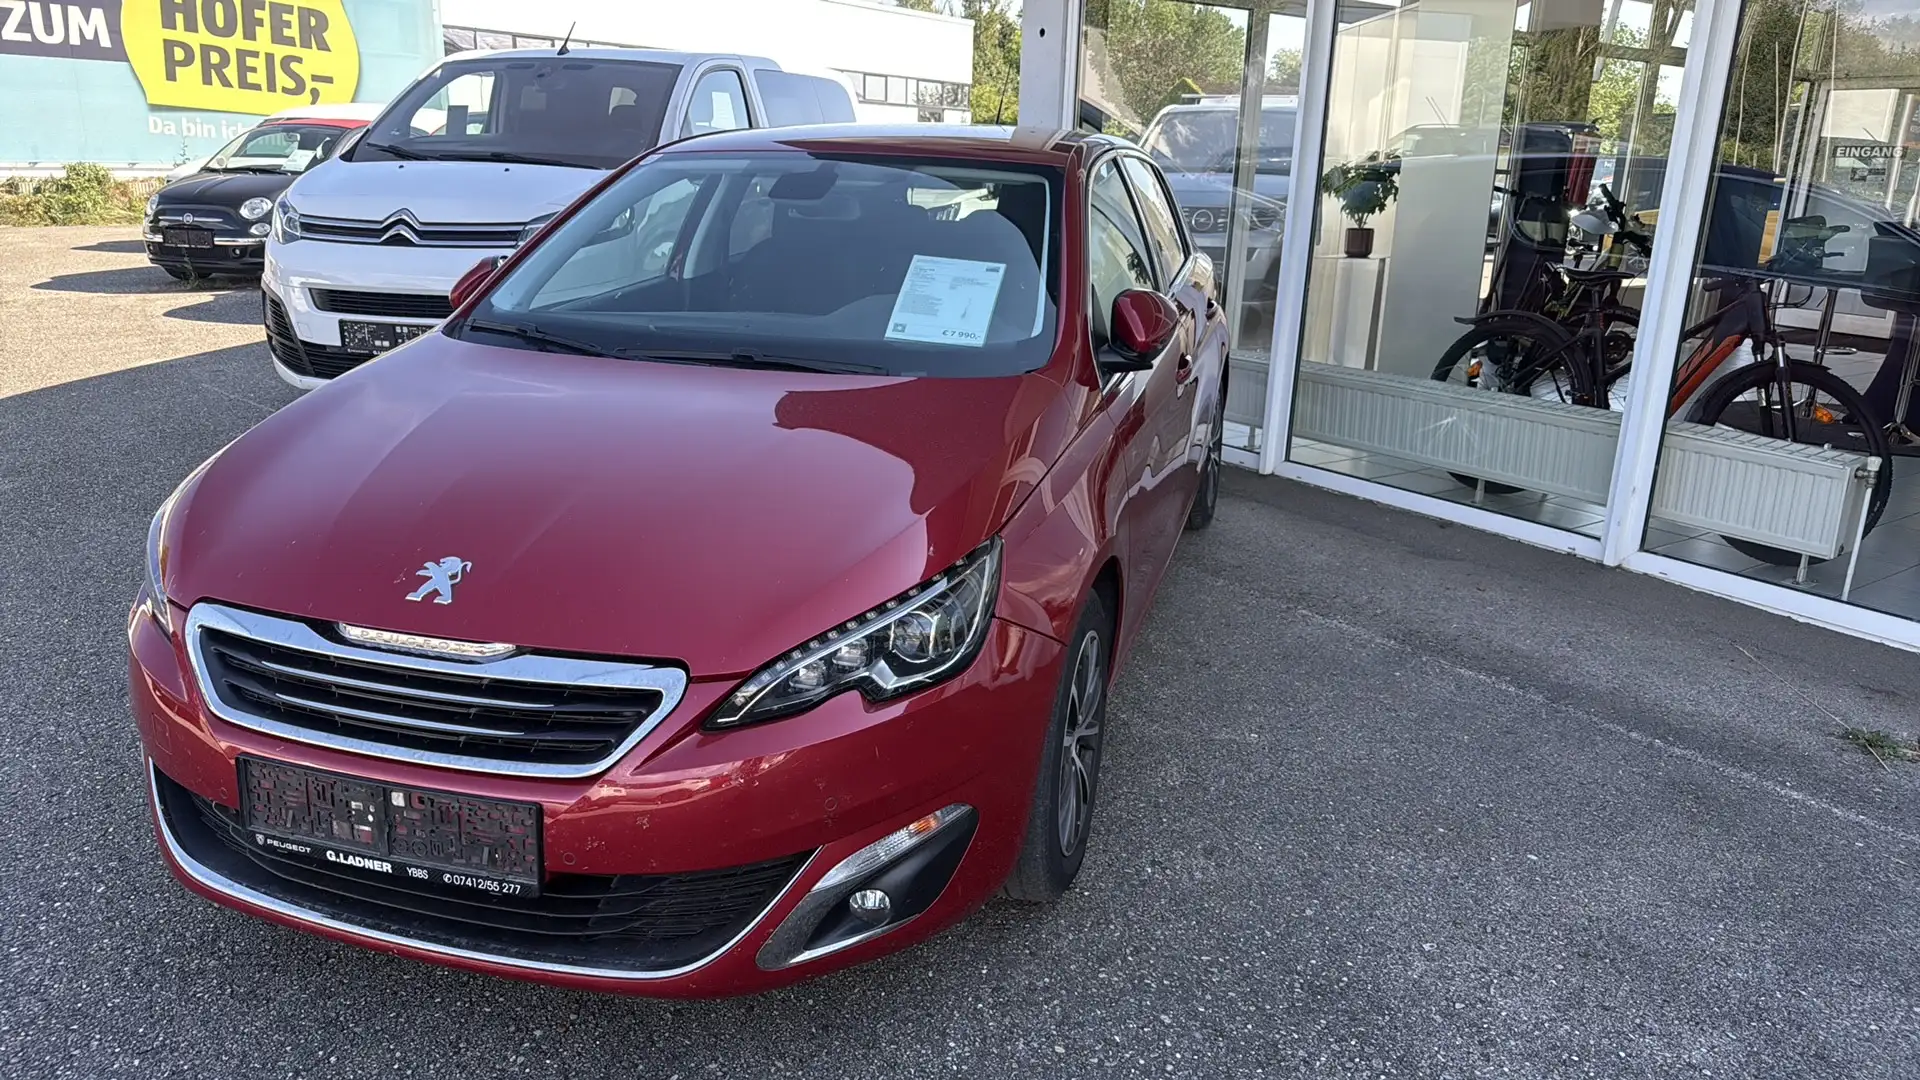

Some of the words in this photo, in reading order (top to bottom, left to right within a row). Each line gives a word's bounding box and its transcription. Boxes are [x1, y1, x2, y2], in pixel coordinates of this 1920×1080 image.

[0, 0, 112, 48] ZUM
[159, 0, 332, 52] HOFER
[148, 115, 177, 135] Da
[182, 117, 216, 138] bin
[1836, 146, 1904, 158] EINGANG
[266, 838, 312, 854] PEUGEOT
[325, 850, 393, 874] G.LADNER
[406, 866, 429, 880] YBBS
[453, 874, 500, 892] 07412/55
[502, 882, 521, 895] 277
